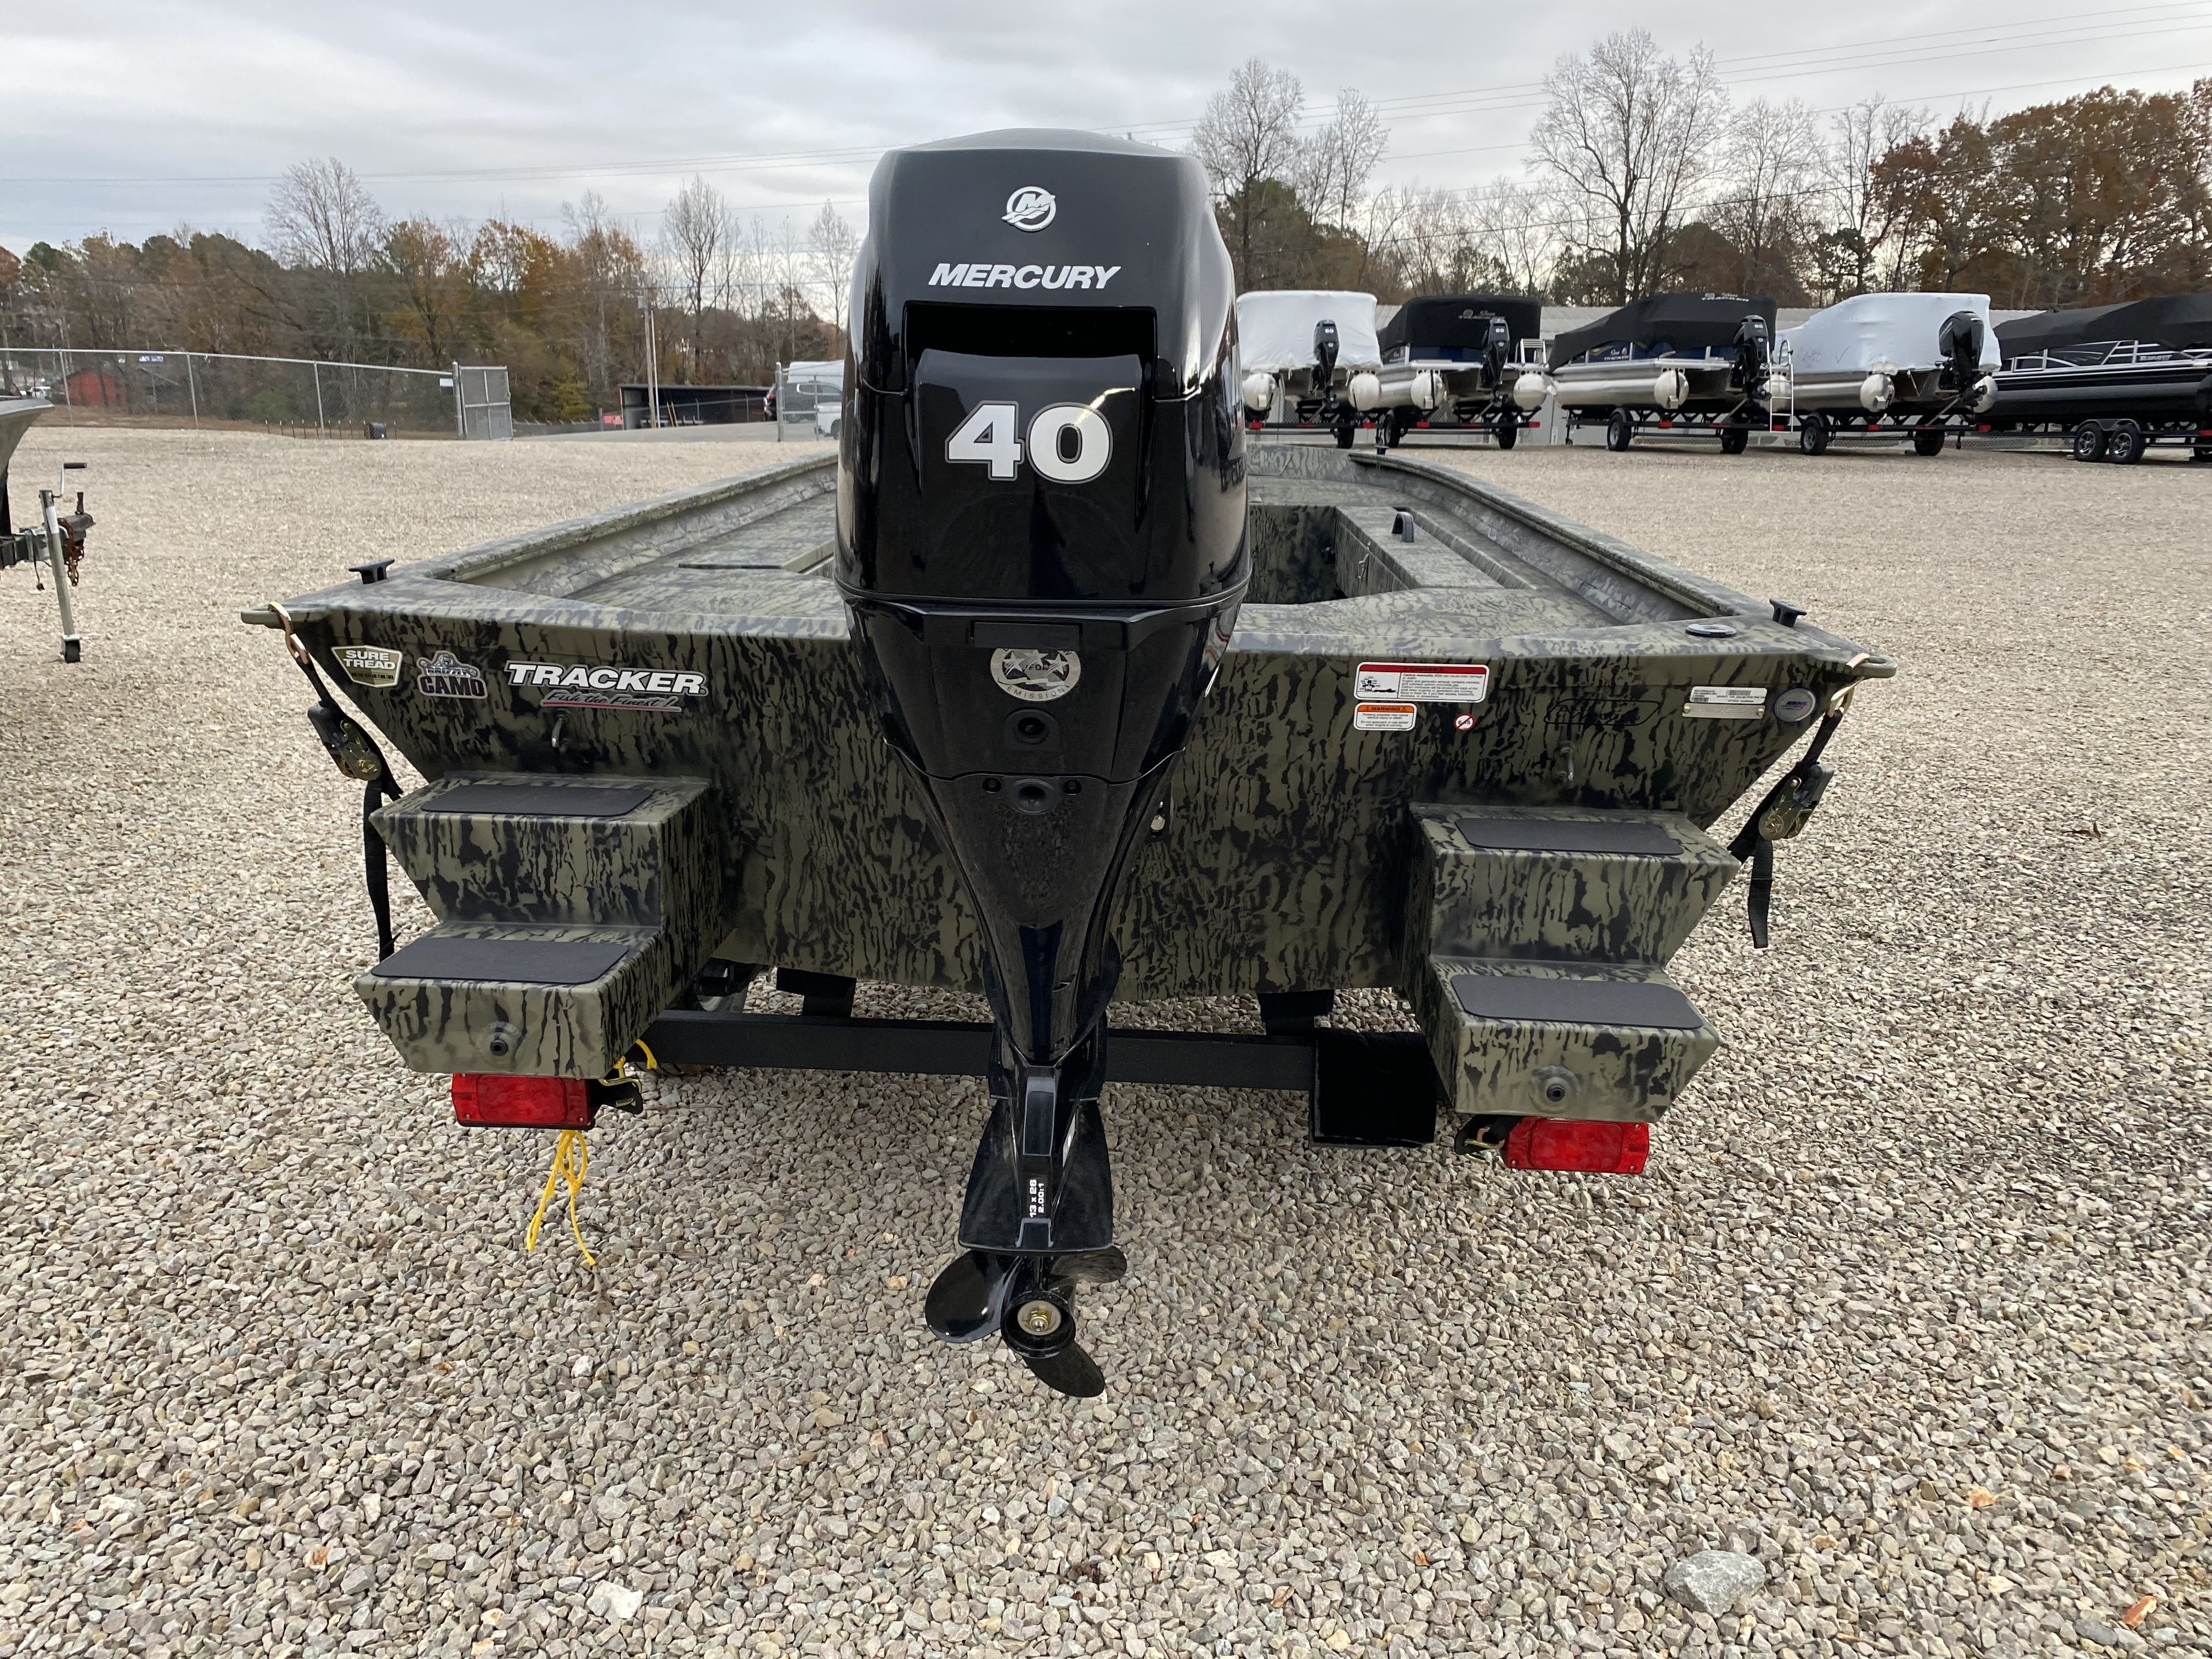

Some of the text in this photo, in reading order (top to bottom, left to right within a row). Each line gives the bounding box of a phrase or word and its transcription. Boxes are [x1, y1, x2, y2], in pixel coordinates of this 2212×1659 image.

[928, 263, 1121, 289] MERCURY
[945, 400, 1114, 484] 40
[346, 650, 390, 661] SURE
[343, 658, 396, 669] TREAD
[508, 664, 705, 694] TRACKER
[420, 676, 486, 697] CAMO
[1007, 685, 1065, 699] EMISSION
[547, 692, 580, 702] Fish
[584, 695, 608, 704] the
[1029, 1179, 1037, 1194] 26
[1029, 1205, 1037, 1218] 13
